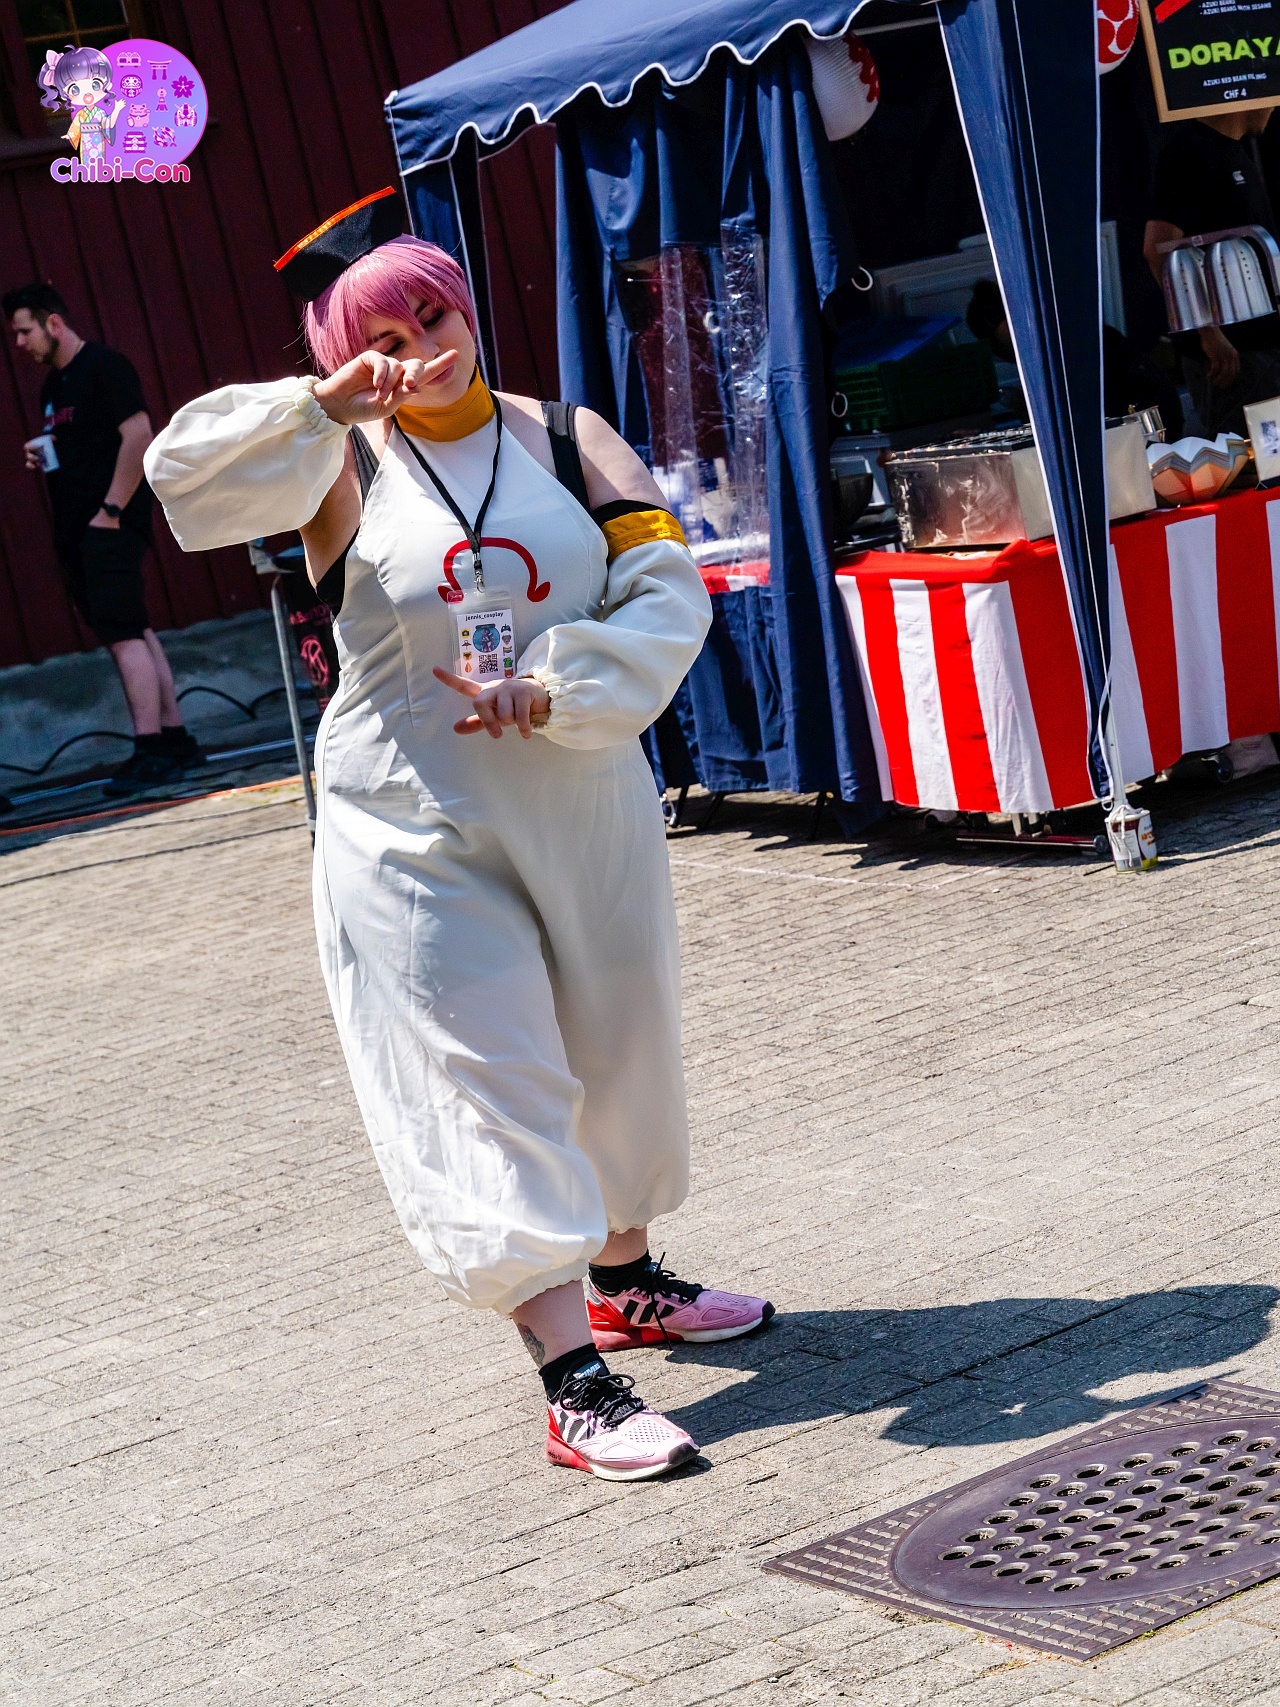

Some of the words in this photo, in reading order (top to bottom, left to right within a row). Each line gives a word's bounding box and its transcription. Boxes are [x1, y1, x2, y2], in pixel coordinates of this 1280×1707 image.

[1223, 89, 1239, 99] CHF
[1240, 88, 1247, 97] 4
[466, 612, 503, 621] jennis_cosplay
